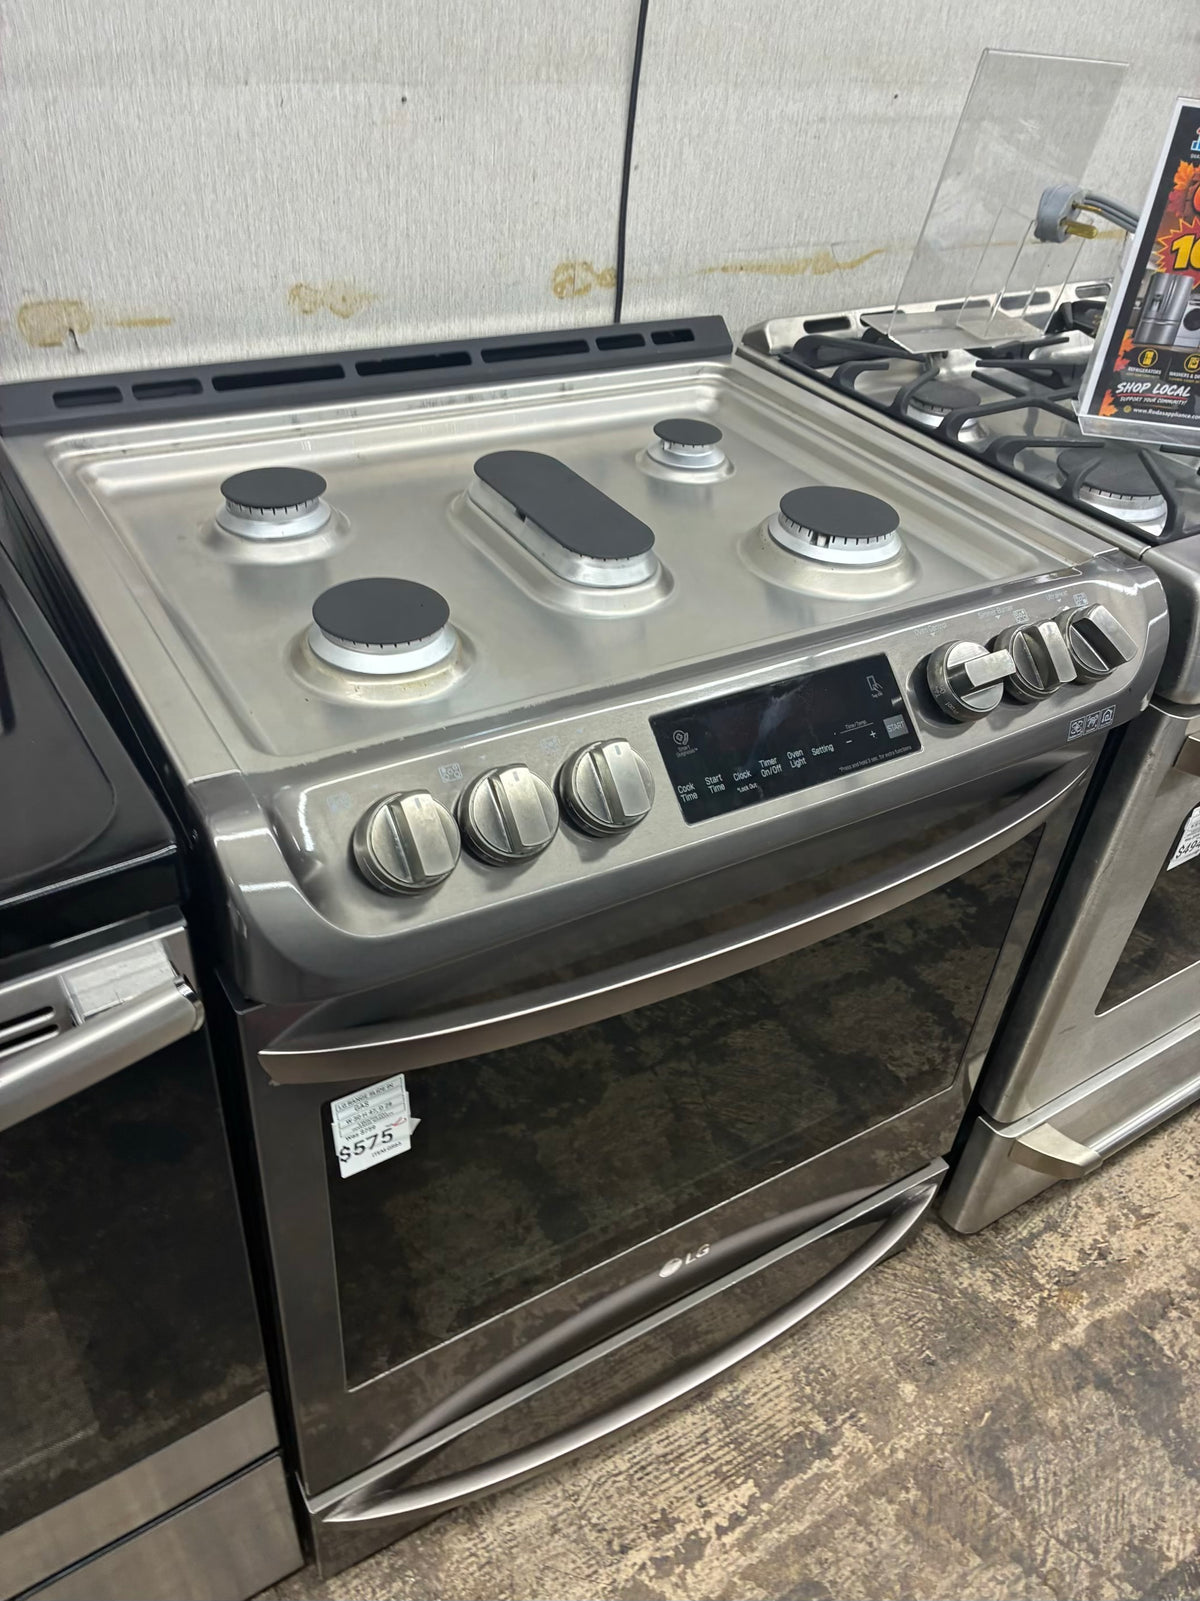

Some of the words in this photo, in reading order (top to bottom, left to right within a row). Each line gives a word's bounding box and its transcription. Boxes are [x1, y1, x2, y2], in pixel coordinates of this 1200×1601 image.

[1127, 366, 1161, 375] REFRIGERATORS
[1116, 382, 1151, 394] SHOP
[1152, 383, 1191, 397] LOCAL
[886, 721, 905, 732] START
[787, 749, 804, 760] Oven
[811, 744, 834, 756] Setting
[759, 757, 778, 768] Timer
[789, 757, 807, 768] Light
[733, 769, 752, 781] Clock
[760, 764, 783, 777] On/Off
[705, 774, 723, 785] Start
[677, 782, 696, 794] Cook
[708, 783, 726, 794] Time
[680, 792, 698, 803] Time
[354, 1101, 370, 1112] GAS
[340, 1128, 393, 1163] $575
[685, 1243, 709, 1265] LG
